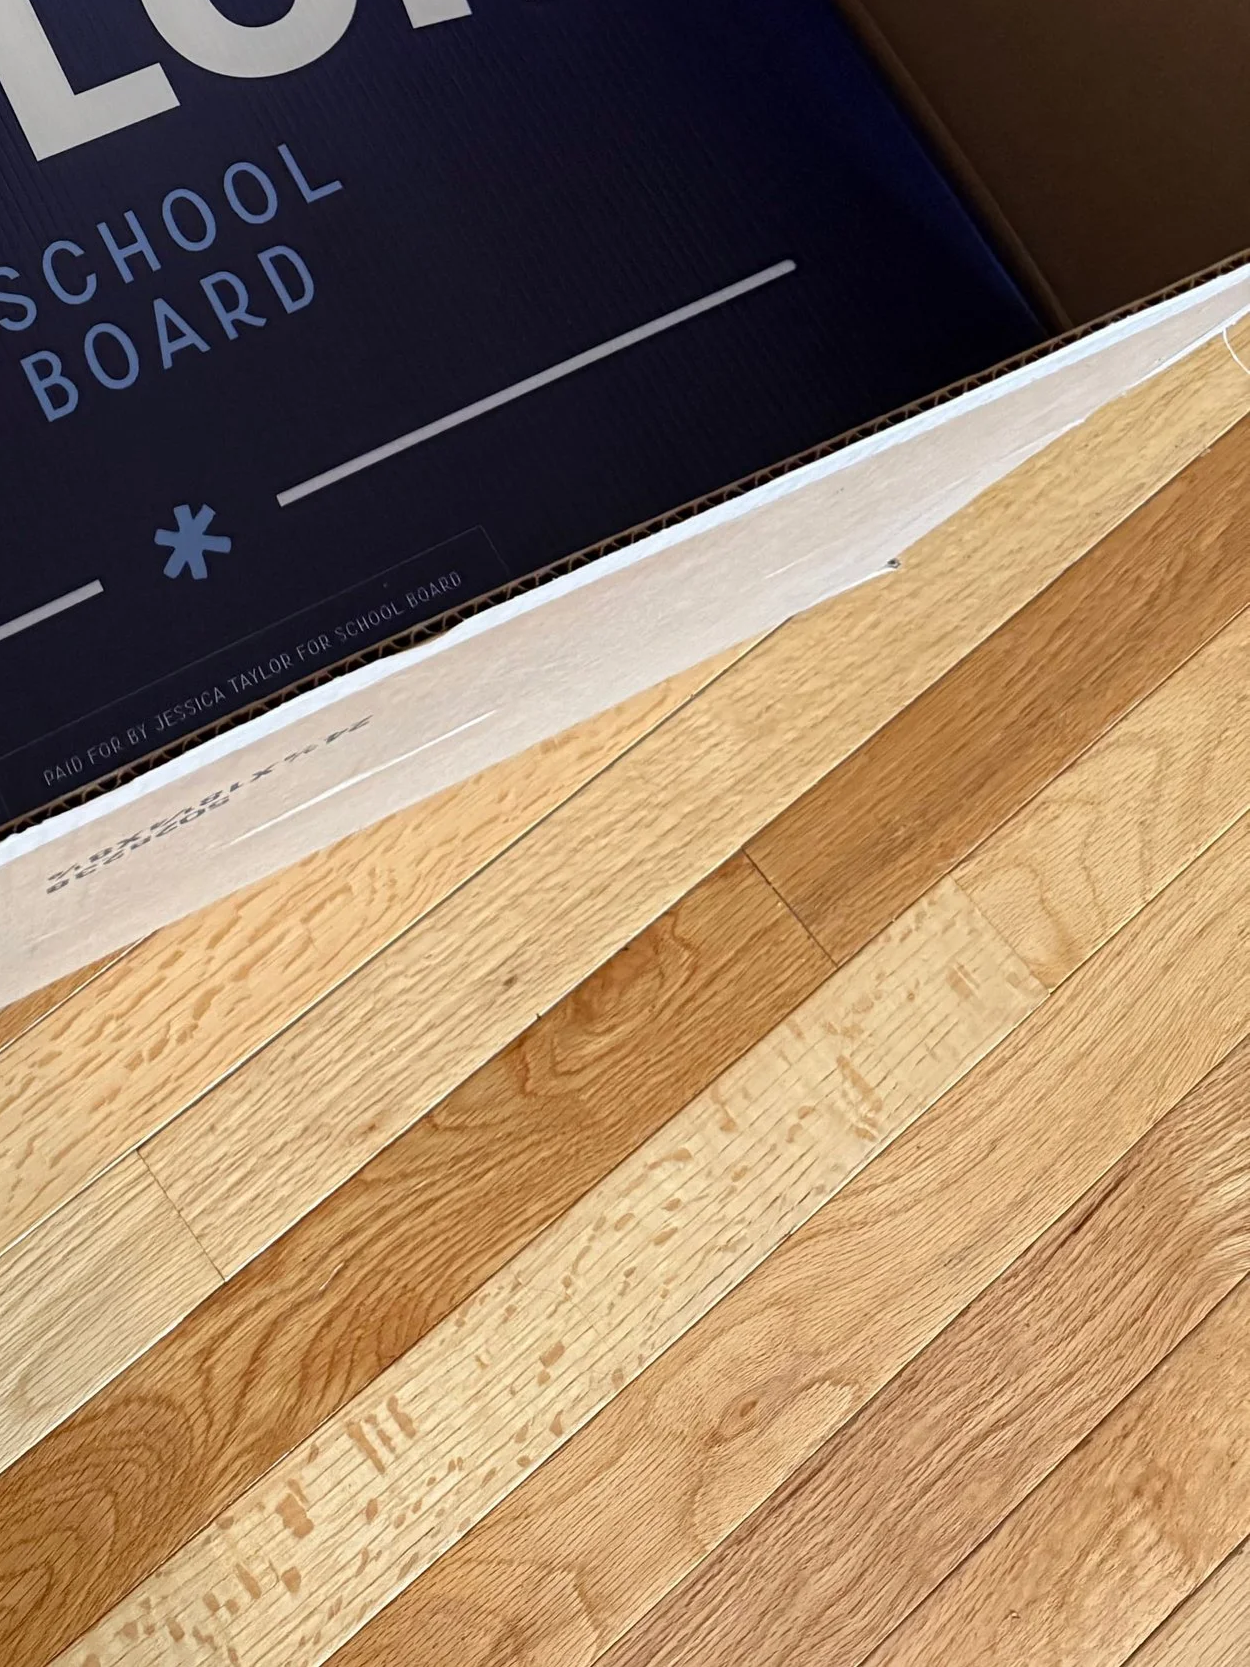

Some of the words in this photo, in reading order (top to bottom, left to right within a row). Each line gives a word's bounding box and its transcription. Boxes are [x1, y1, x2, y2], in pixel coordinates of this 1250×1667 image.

[20, 245, 315, 422] BOARD
[43, 755, 83, 786] PAID
[87, 736, 123, 765] FOR
[127, 722, 148, 747] BY
[154, 686, 226, 732] JESSICA
[227, 652, 293, 694] TAYLOR
[295, 634, 332, 663] FOR
[334, 601, 404, 643] SCHOOL
[406, 570, 463, 608] BOARD
